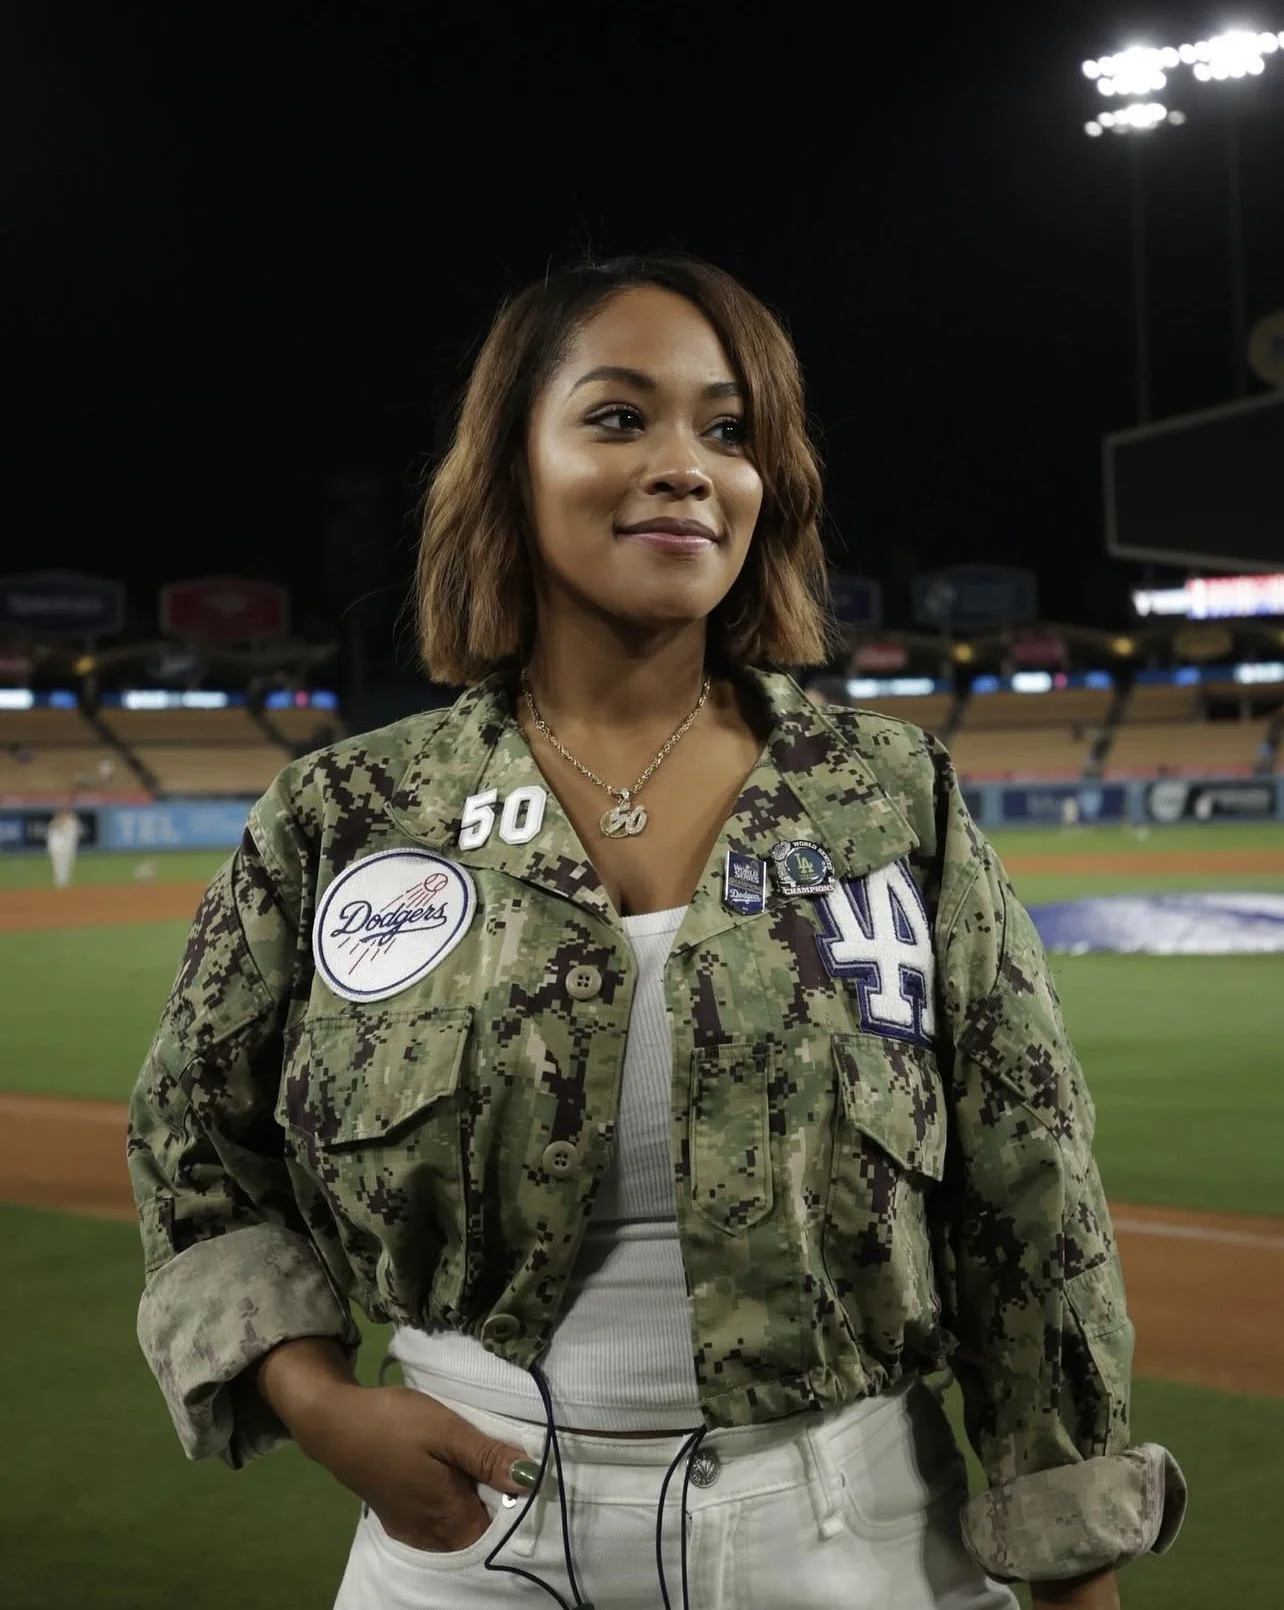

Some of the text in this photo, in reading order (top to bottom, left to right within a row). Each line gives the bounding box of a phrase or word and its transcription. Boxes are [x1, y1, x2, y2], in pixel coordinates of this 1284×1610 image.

[459, 785, 548, 851] 50
[606, 804, 648, 834] 50
[793, 841, 818, 850] WORLD
[794, 852, 815, 874] LA
[784, 884, 835, 895] CHAMPIONS
[331, 900, 448, 946] Dodgers
[814, 857, 934, 1046] LA
